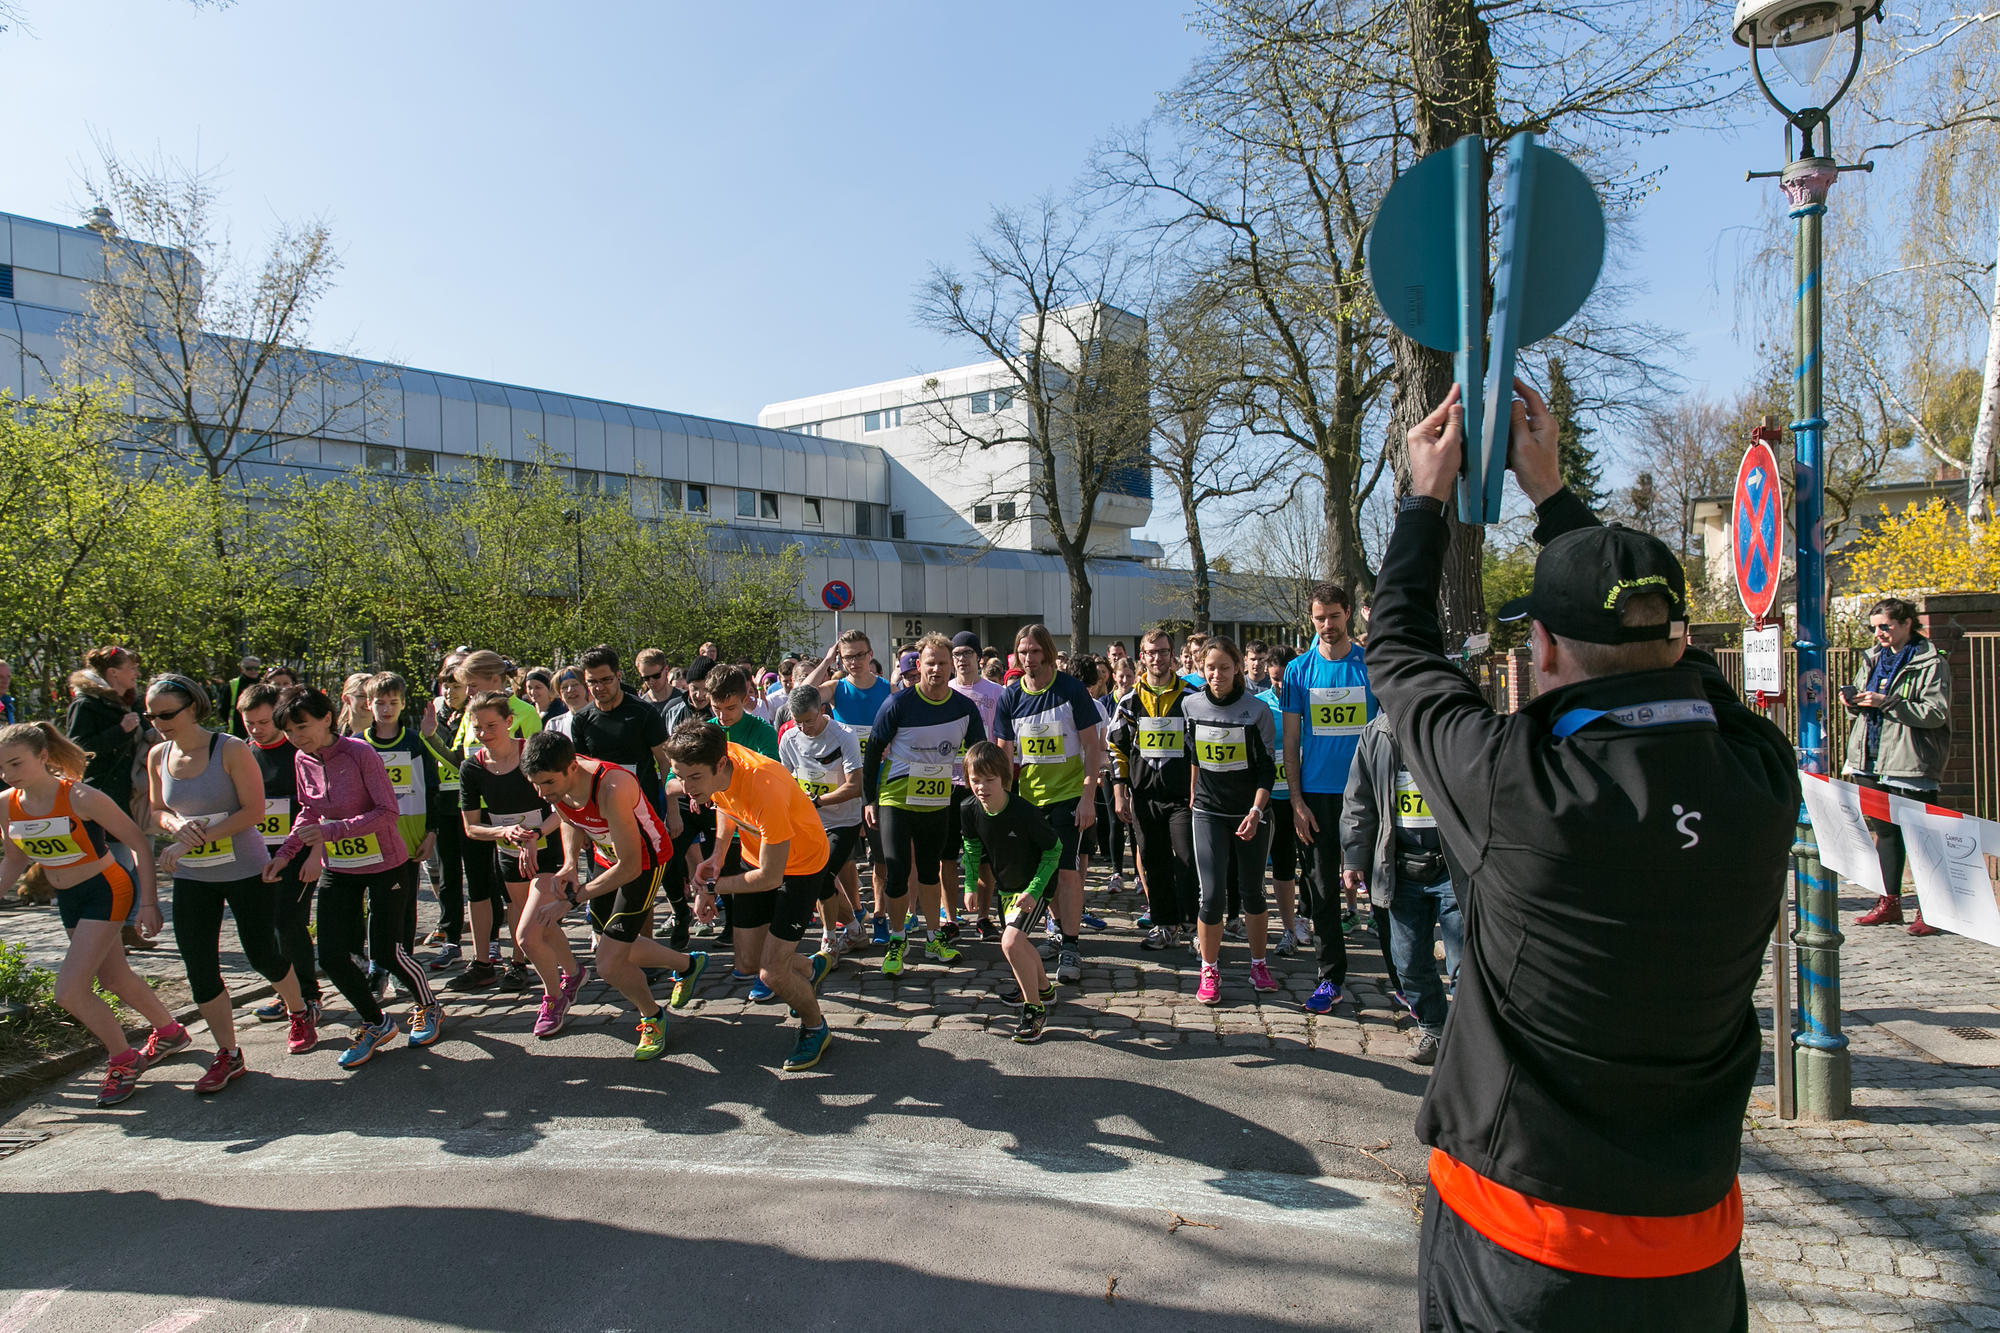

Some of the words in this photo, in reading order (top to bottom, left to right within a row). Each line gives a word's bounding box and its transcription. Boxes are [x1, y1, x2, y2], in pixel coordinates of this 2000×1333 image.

[905, 620, 922, 636] 26
[1320, 706, 1356, 724] 367
[1028, 739, 1056, 753] 274
[1147, 733, 1175, 747] 277
[1205, 744, 1236, 761] 157
[916, 780, 945, 795] 230
[24, 838, 68, 855] 290
[333, 838, 369, 856] 168
